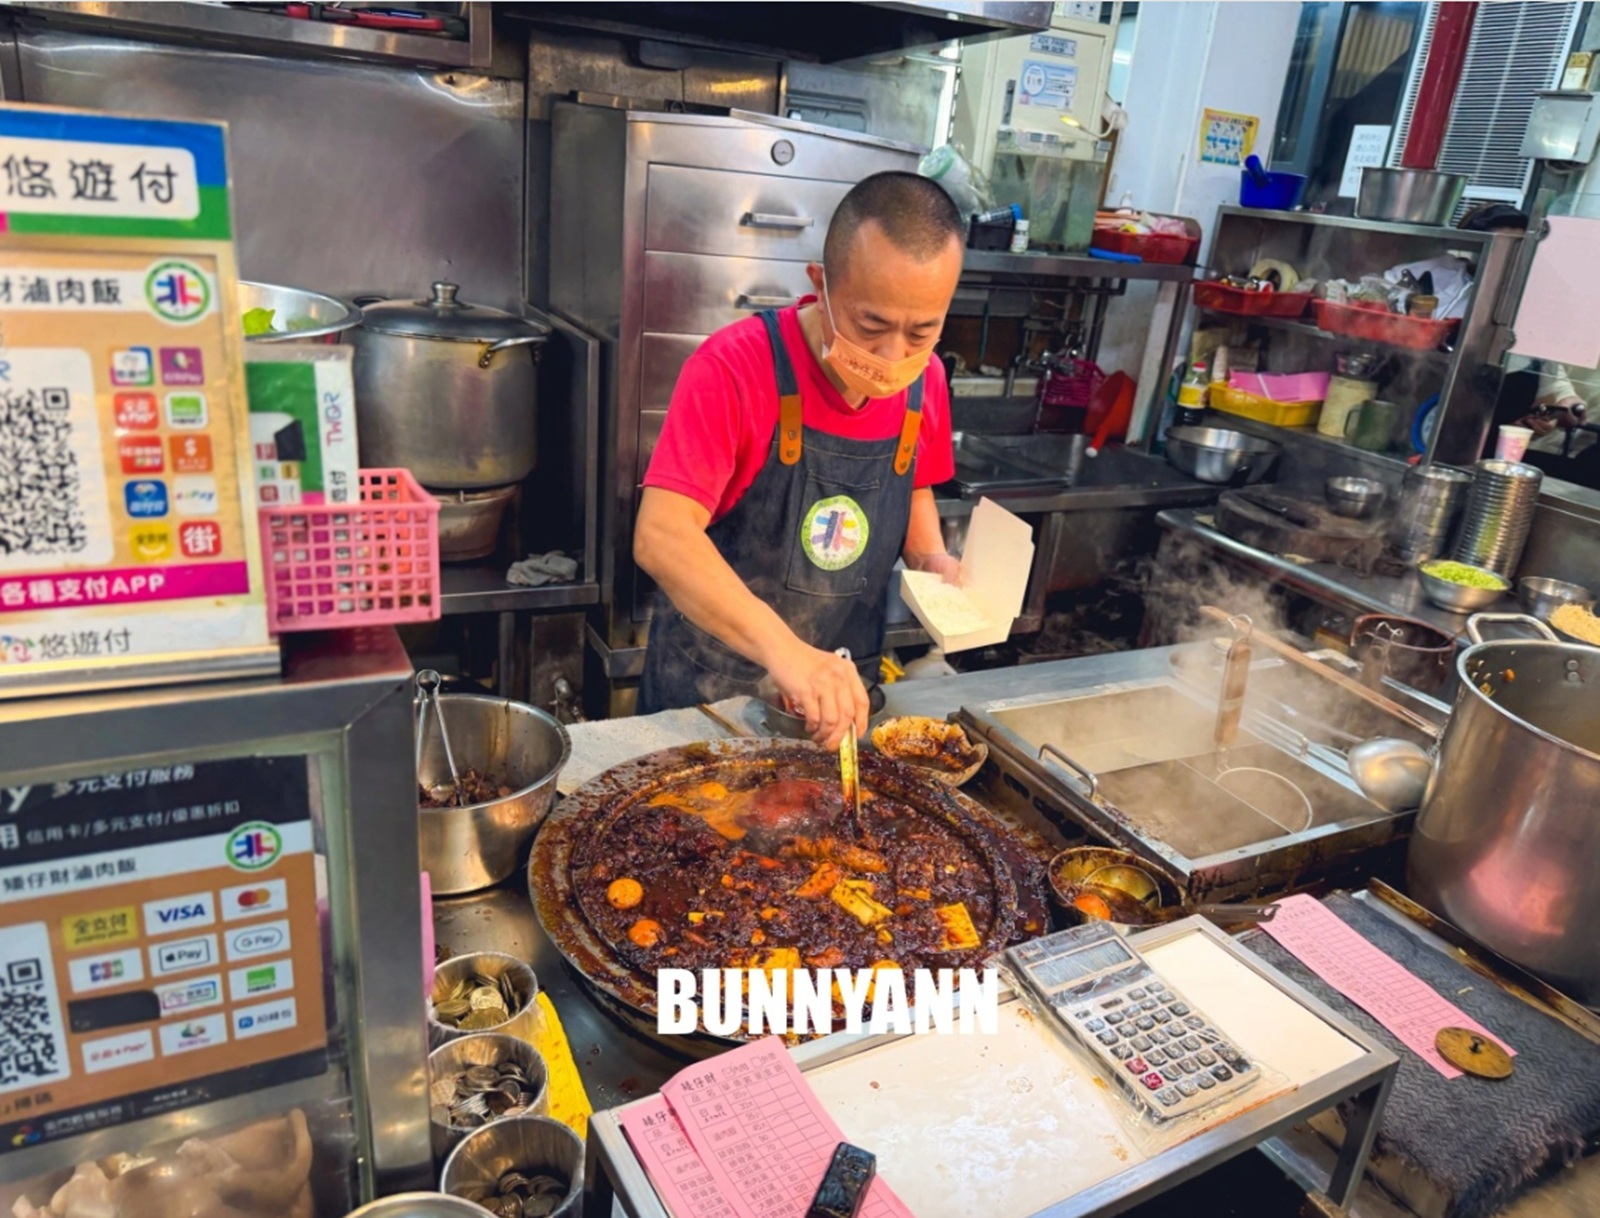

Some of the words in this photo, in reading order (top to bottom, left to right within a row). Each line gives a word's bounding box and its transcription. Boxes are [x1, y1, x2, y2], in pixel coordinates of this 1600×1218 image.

[2, 153, 179, 204] 悠遊付
[183, 524, 217, 554] 街
[1, 573, 165, 606] 各種支付APP
[39, 627, 132, 660] 悠遊付
[158, 904, 206, 924] VISA
[177, 949, 202, 965] Pay
